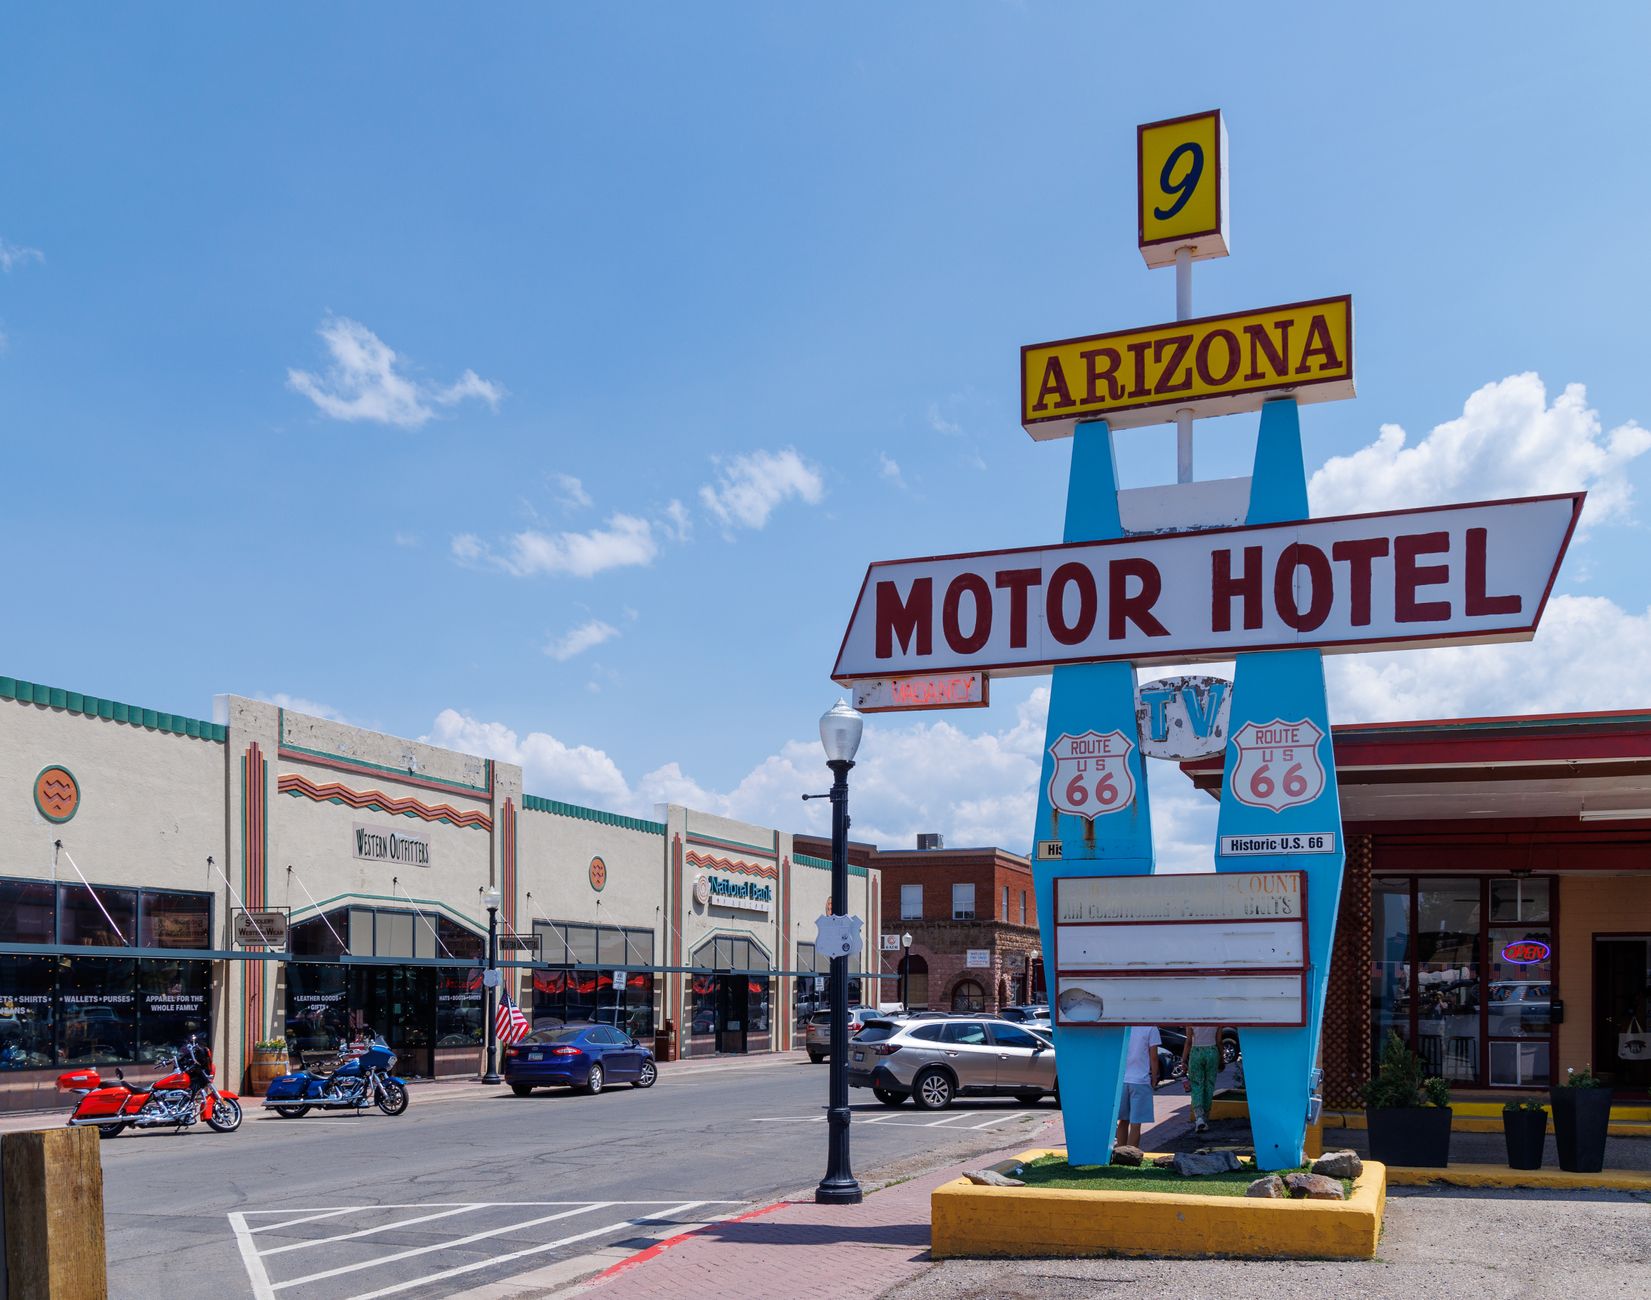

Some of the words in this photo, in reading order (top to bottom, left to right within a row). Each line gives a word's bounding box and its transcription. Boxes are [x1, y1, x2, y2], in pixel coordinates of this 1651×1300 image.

[1153, 142, 1205, 221] 9
[1032, 314, 1343, 412] ARIZONA
[875, 557, 1172, 660] MOTOR
[1211, 527, 1522, 632] HOTEL
[891, 676, 973, 704] VACANCY
[1139, 683, 1228, 742] TV
[1070, 739, 1112, 756] ROUTE
[1255, 728, 1300, 745] ROUTE
[1066, 771, 1119, 807] 66
[1250, 763, 1308, 798] 66
[1230, 837, 1278, 852] Historic
[1280, 837, 1305, 851] U.S.
[1308, 836, 1324, 850] 66
[708, 875, 749, 898] National
[749, 882, 772, 901] Bank
[1504, 944, 1546, 960] OPEN
[18, 995, 48, 1003] SHIRTS
[64, 995, 99, 1003] WALLETS
[103, 995, 131, 1003] PURSES
